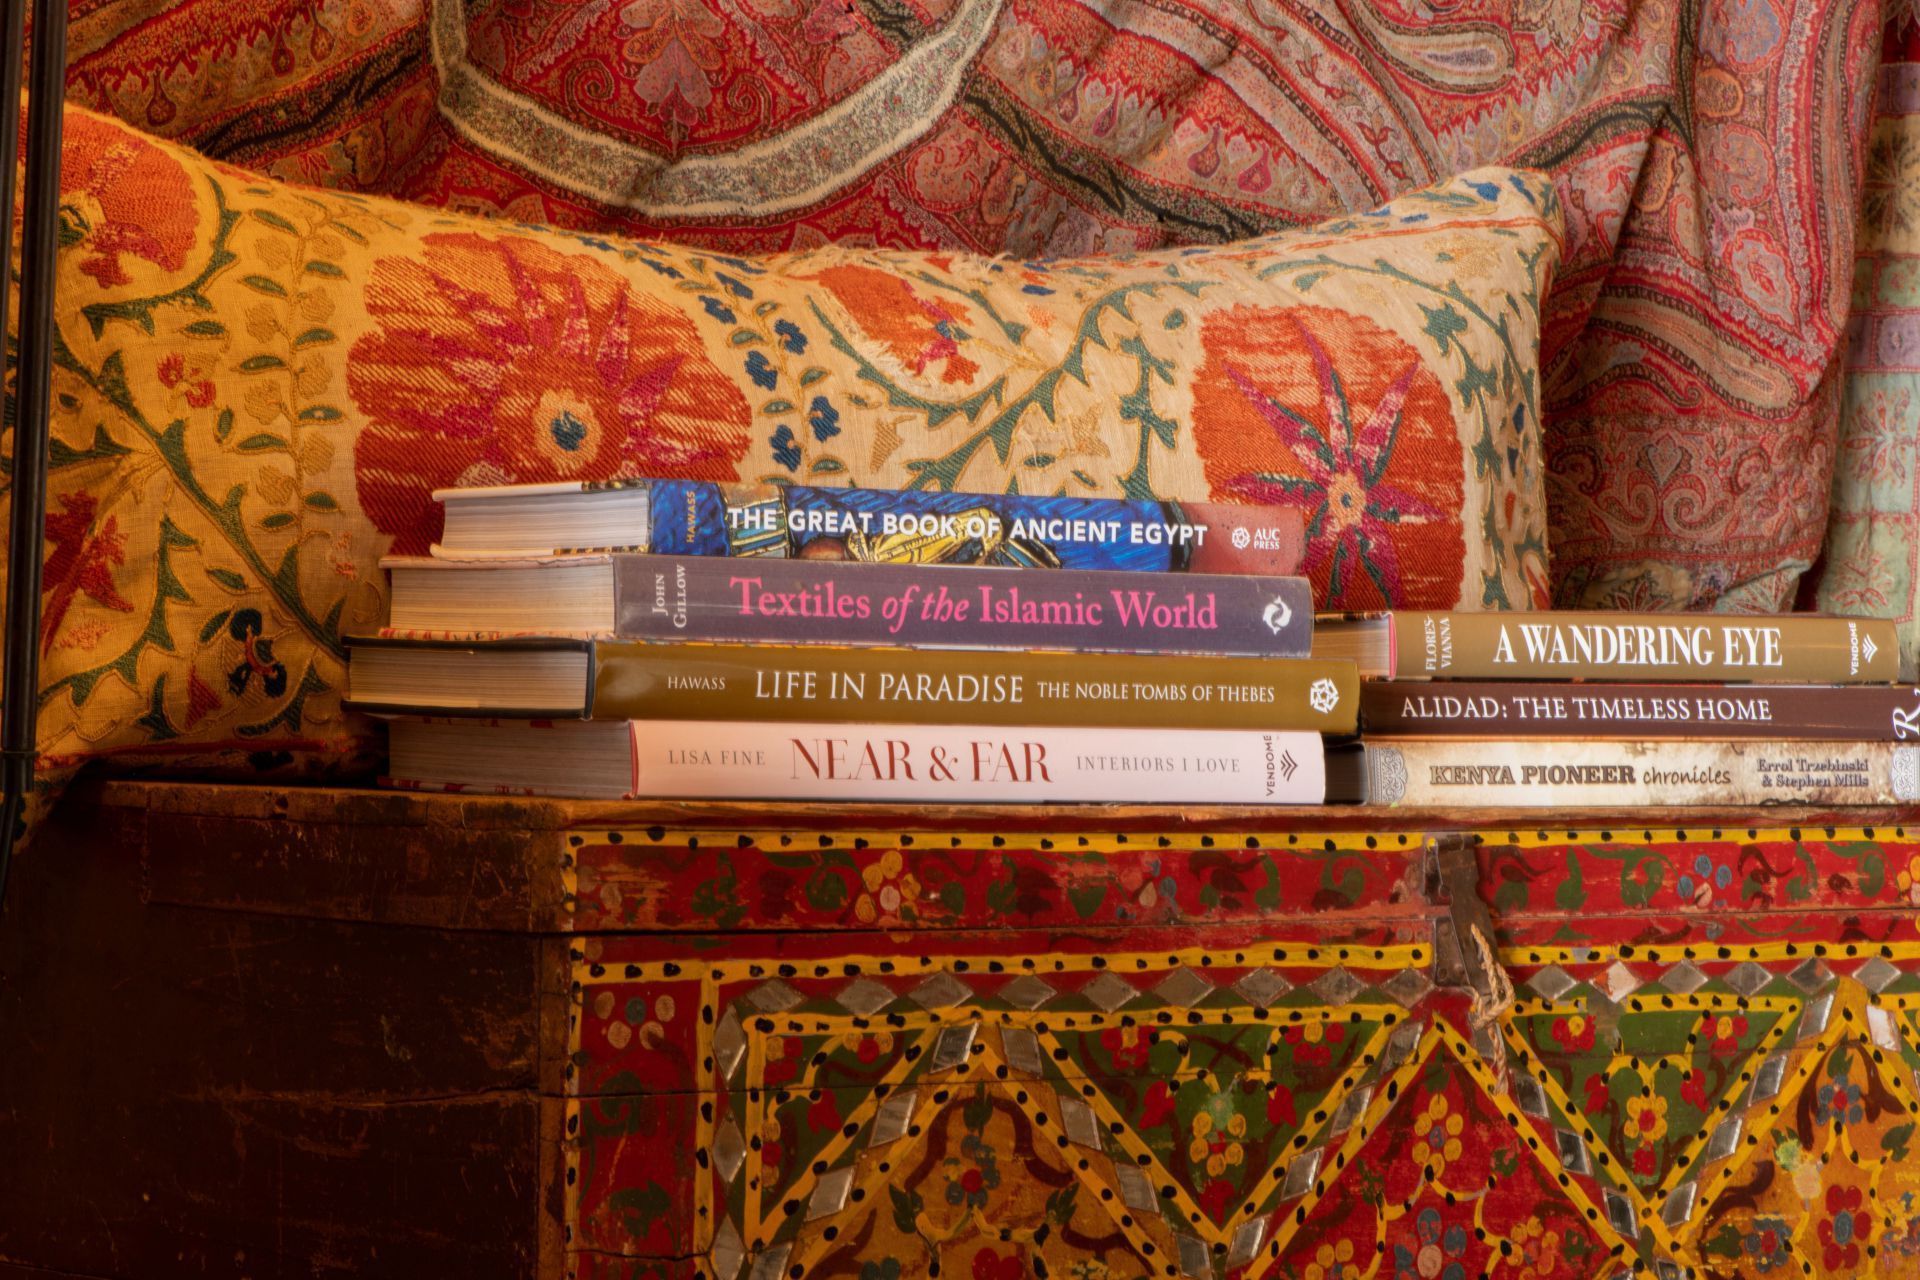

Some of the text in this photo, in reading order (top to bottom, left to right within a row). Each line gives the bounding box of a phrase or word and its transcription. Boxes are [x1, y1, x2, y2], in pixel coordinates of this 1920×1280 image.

[686, 490, 696, 543] HAWASS
[727, 508, 1208, 546] THE GREAT BOOK OF ANCIENT EGYPT
[1254, 528, 1280, 541] AUC
[1254, 540, 1280, 550] PRESS
[652, 574, 668, 616] JOHN
[673, 564, 687, 628] GILLOW
[729, 576, 1218, 633] Textiles of the Islamic World
[1424, 615, 1437, 670] FLORES-
[1440, 617, 1452, 669] VIANNA
[1492, 623, 1783, 667] A WANDERING EYE
[1848, 622, 1859, 676] VENDOME
[668, 676, 726, 690] HAWASS
[755, 670, 1023, 703] LIFE IN PARADISE
[1037, 681, 1275, 703] THE NOBLE TOMBS OF THEBES
[1401, 696, 1773, 721] ALIDAD: THE TIMELESS HOME
[668, 750, 766, 766] LISA FINE
[788, 739, 1054, 783] NEAR & FAR
[1077, 756, 1241, 773] INTERIORS I LOVE
[1264, 735, 1275, 797] VENDOME
[1430, 765, 1731, 785] KENYA PIONEER chronicles
[1757, 758, 1869, 772] Errol Trzebinski
[1762, 773, 1869, 791] & Stephen Mills
